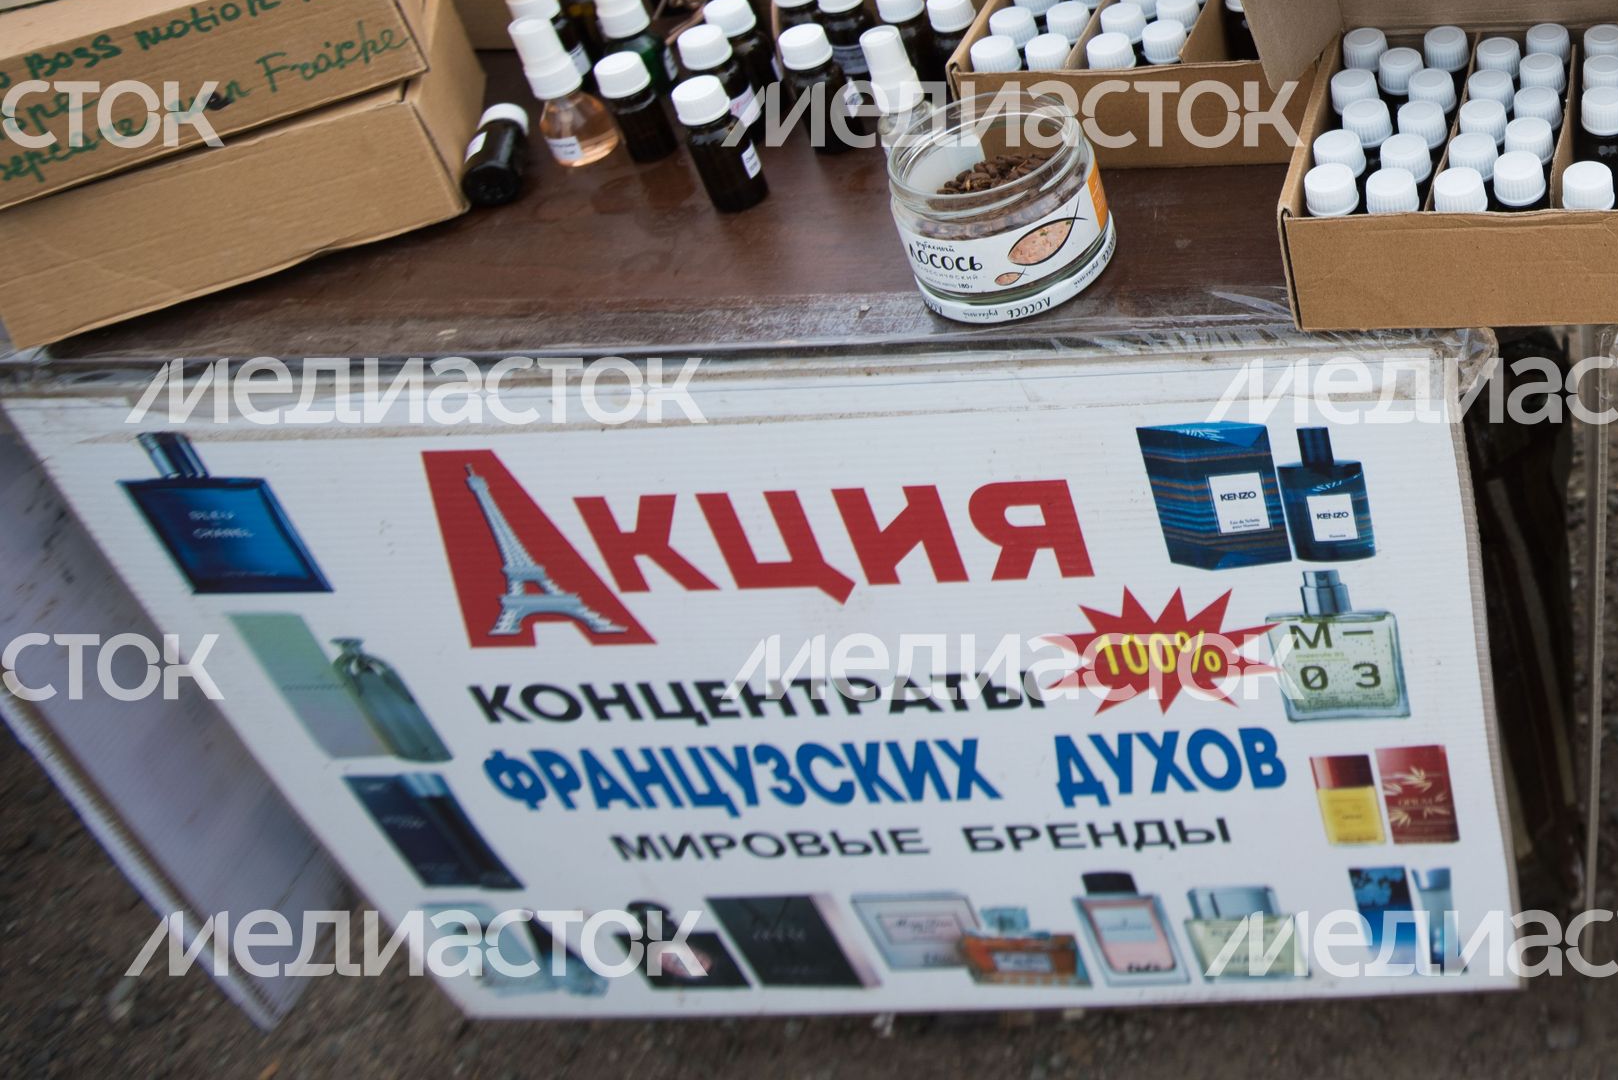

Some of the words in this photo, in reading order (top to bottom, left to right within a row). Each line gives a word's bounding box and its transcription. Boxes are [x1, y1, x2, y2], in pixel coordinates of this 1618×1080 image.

[24, 33, 122, 77] Boss
[1220, 491, 1257, 502] KENZO
[1316, 511, 1350, 520] KENZO
[1095, 631, 1223, 677] 100%
[469, 671, 1046, 726] КОНЦЕНТРАТЫ
[484, 738, 1002, 819] ФРАНЦУЗСКИХ
[1054, 727, 1287, 809] ДУХОВ
[611, 827, 930, 862] МИРОВЫЕ
[962, 818, 1231, 854] БРЕНДЫ
